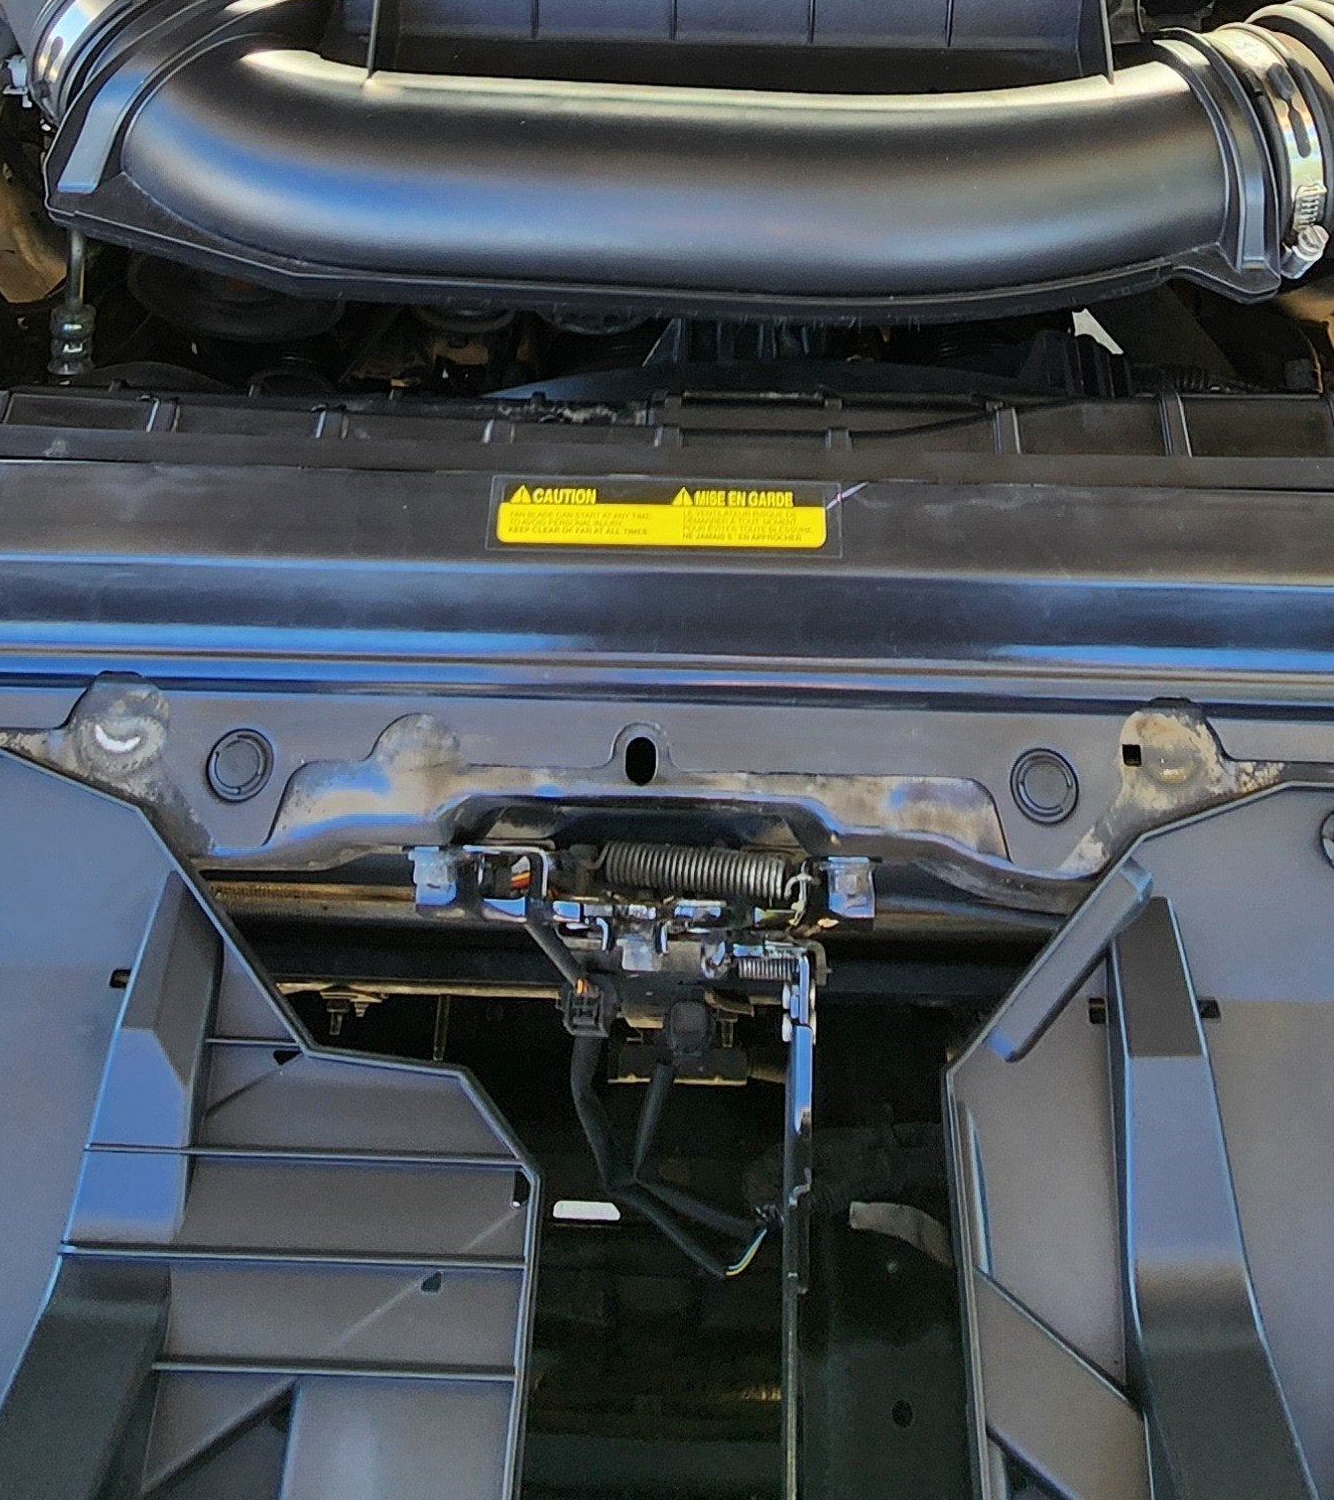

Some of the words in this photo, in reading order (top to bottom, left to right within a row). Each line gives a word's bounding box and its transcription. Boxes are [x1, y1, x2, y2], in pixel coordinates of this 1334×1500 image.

[532, 487, 597, 505] CAUTION
[694, 490, 726, 507] MISE
[727, 490, 747, 507] EN
[747, 491, 794, 508] GARDE
